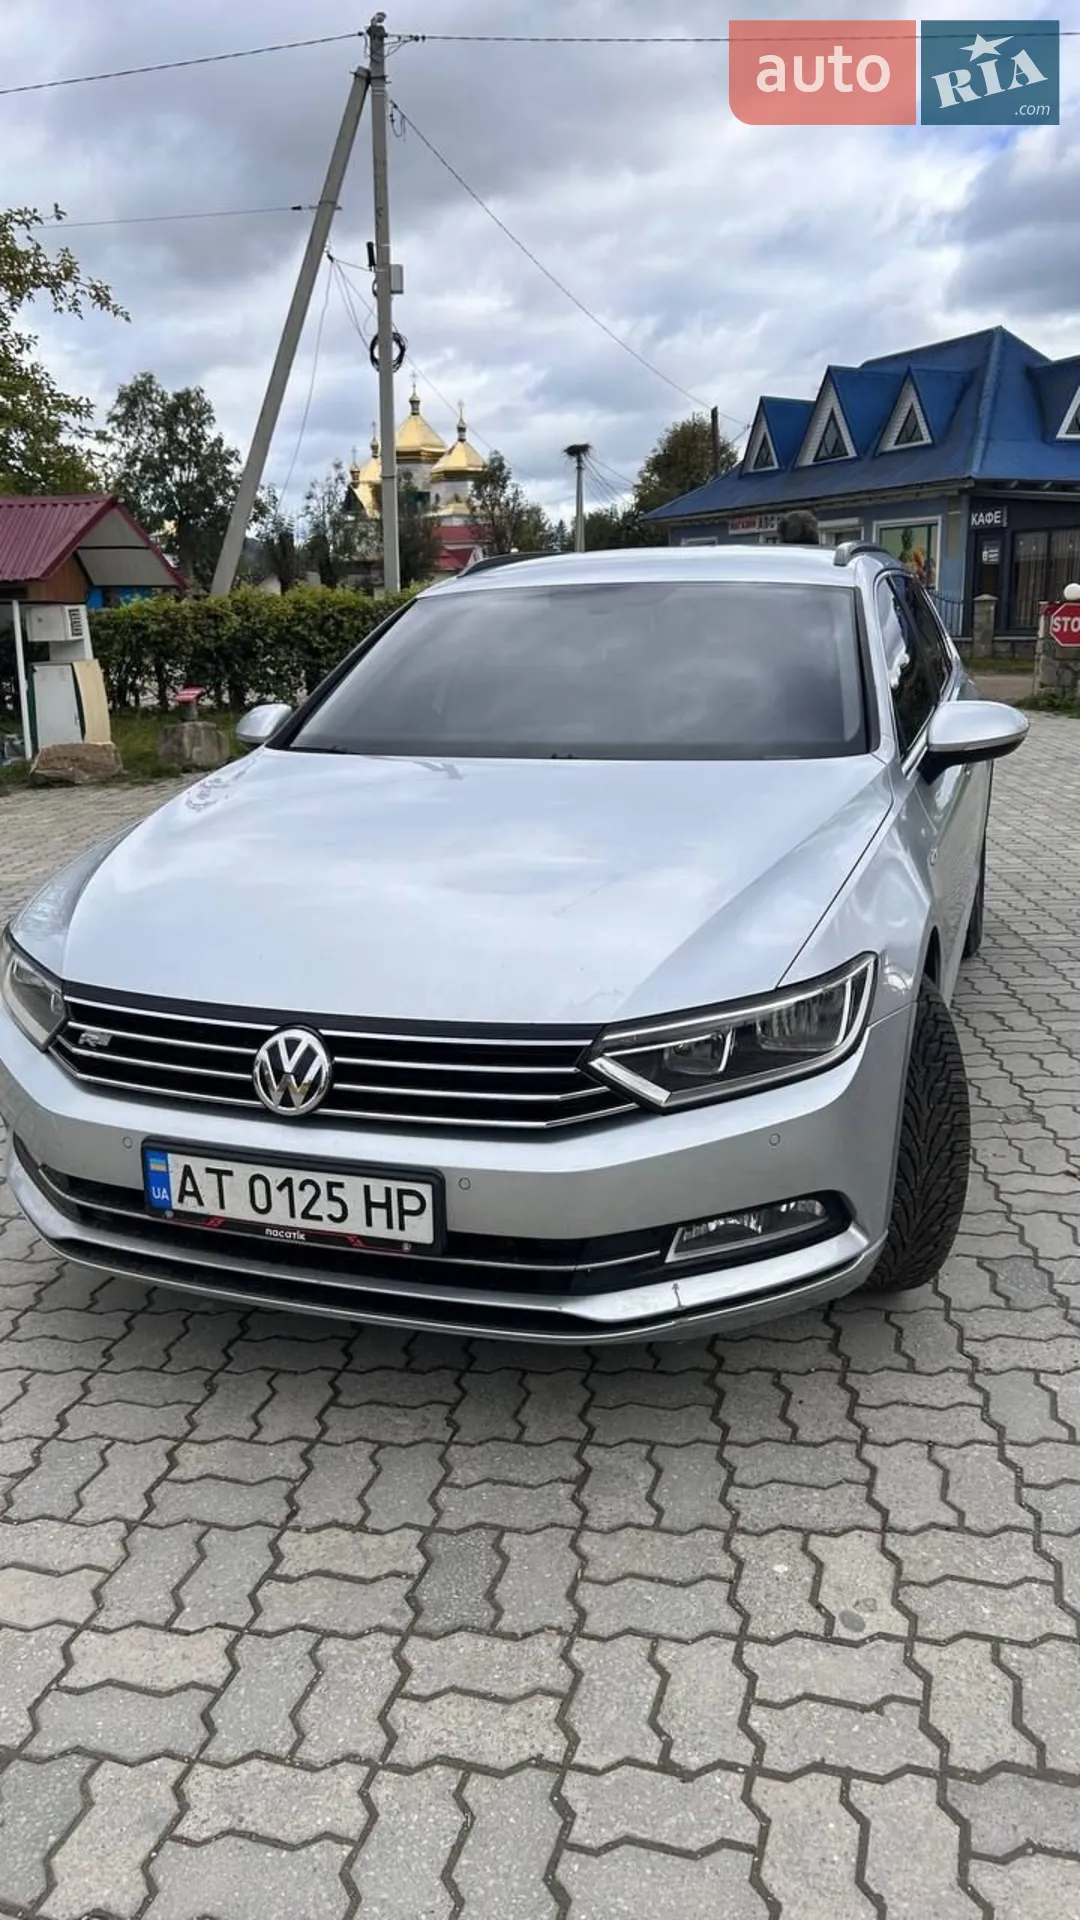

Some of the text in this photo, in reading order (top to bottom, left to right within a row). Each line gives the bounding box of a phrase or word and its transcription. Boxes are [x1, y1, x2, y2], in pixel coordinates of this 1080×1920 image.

[971, 510, 1002, 526] КАФЕ
[152, 1187, 170, 1201] UA
[177, 1164, 427, 1231] AT 0125 HP
